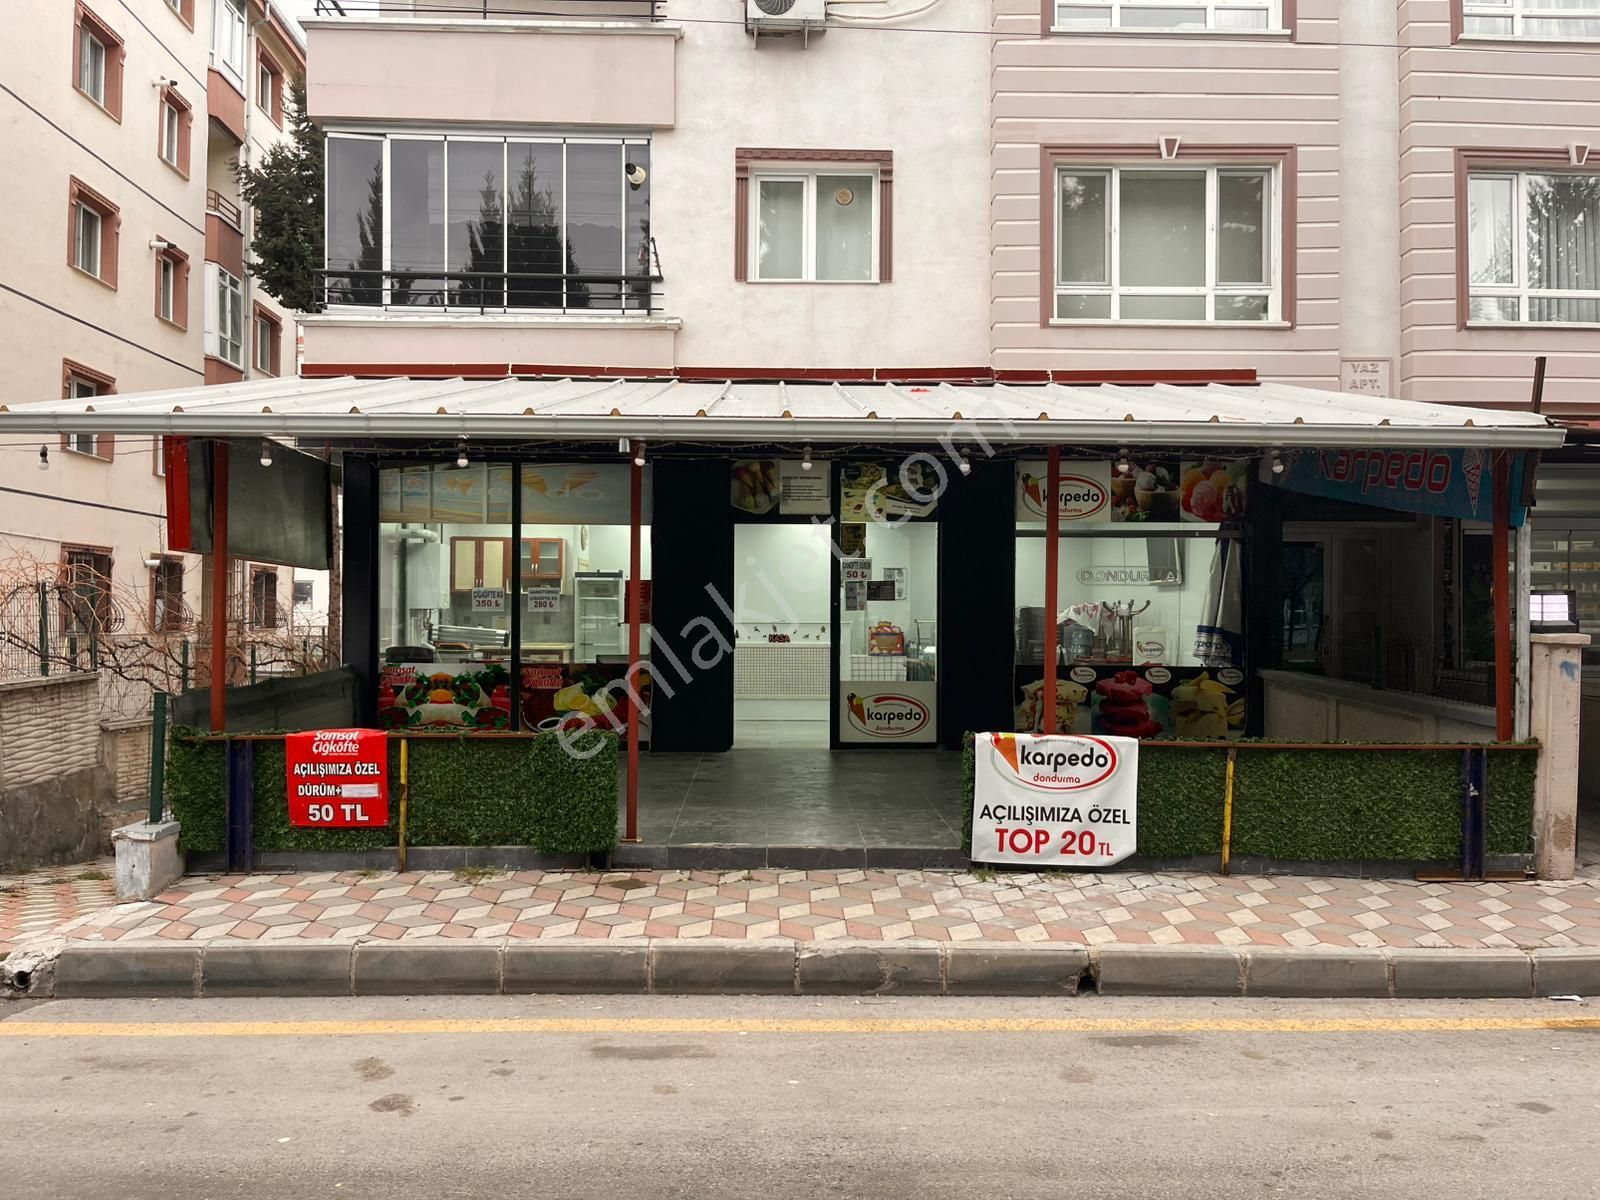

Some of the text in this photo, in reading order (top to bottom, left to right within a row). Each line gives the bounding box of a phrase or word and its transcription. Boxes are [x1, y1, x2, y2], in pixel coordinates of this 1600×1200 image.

[1350, 362, 1379, 373] YAZ
[1349, 378, 1381, 390] APT.
[1315, 449, 1451, 494] Karpedo
[1042, 489, 1100, 506] krpedo
[847, 570, 858, 578] 50
[1080, 570, 1176, 582] DONDURA
[769, 633, 791, 643] KASA
[867, 708, 922, 725] karpedo
[314, 730, 359, 740] Samsat
[1021, 745, 1109, 773] karpedo
[293, 761, 380, 778] AÇILIŞIMIZA ÖZEL
[1033, 773, 1081, 784] dondurma
[308, 804, 369, 821] 50 TL
[979, 804, 1131, 826] AÇILIŞIMIZA ÖZEL
[995, 828, 1114, 857] TOP 20 TL
